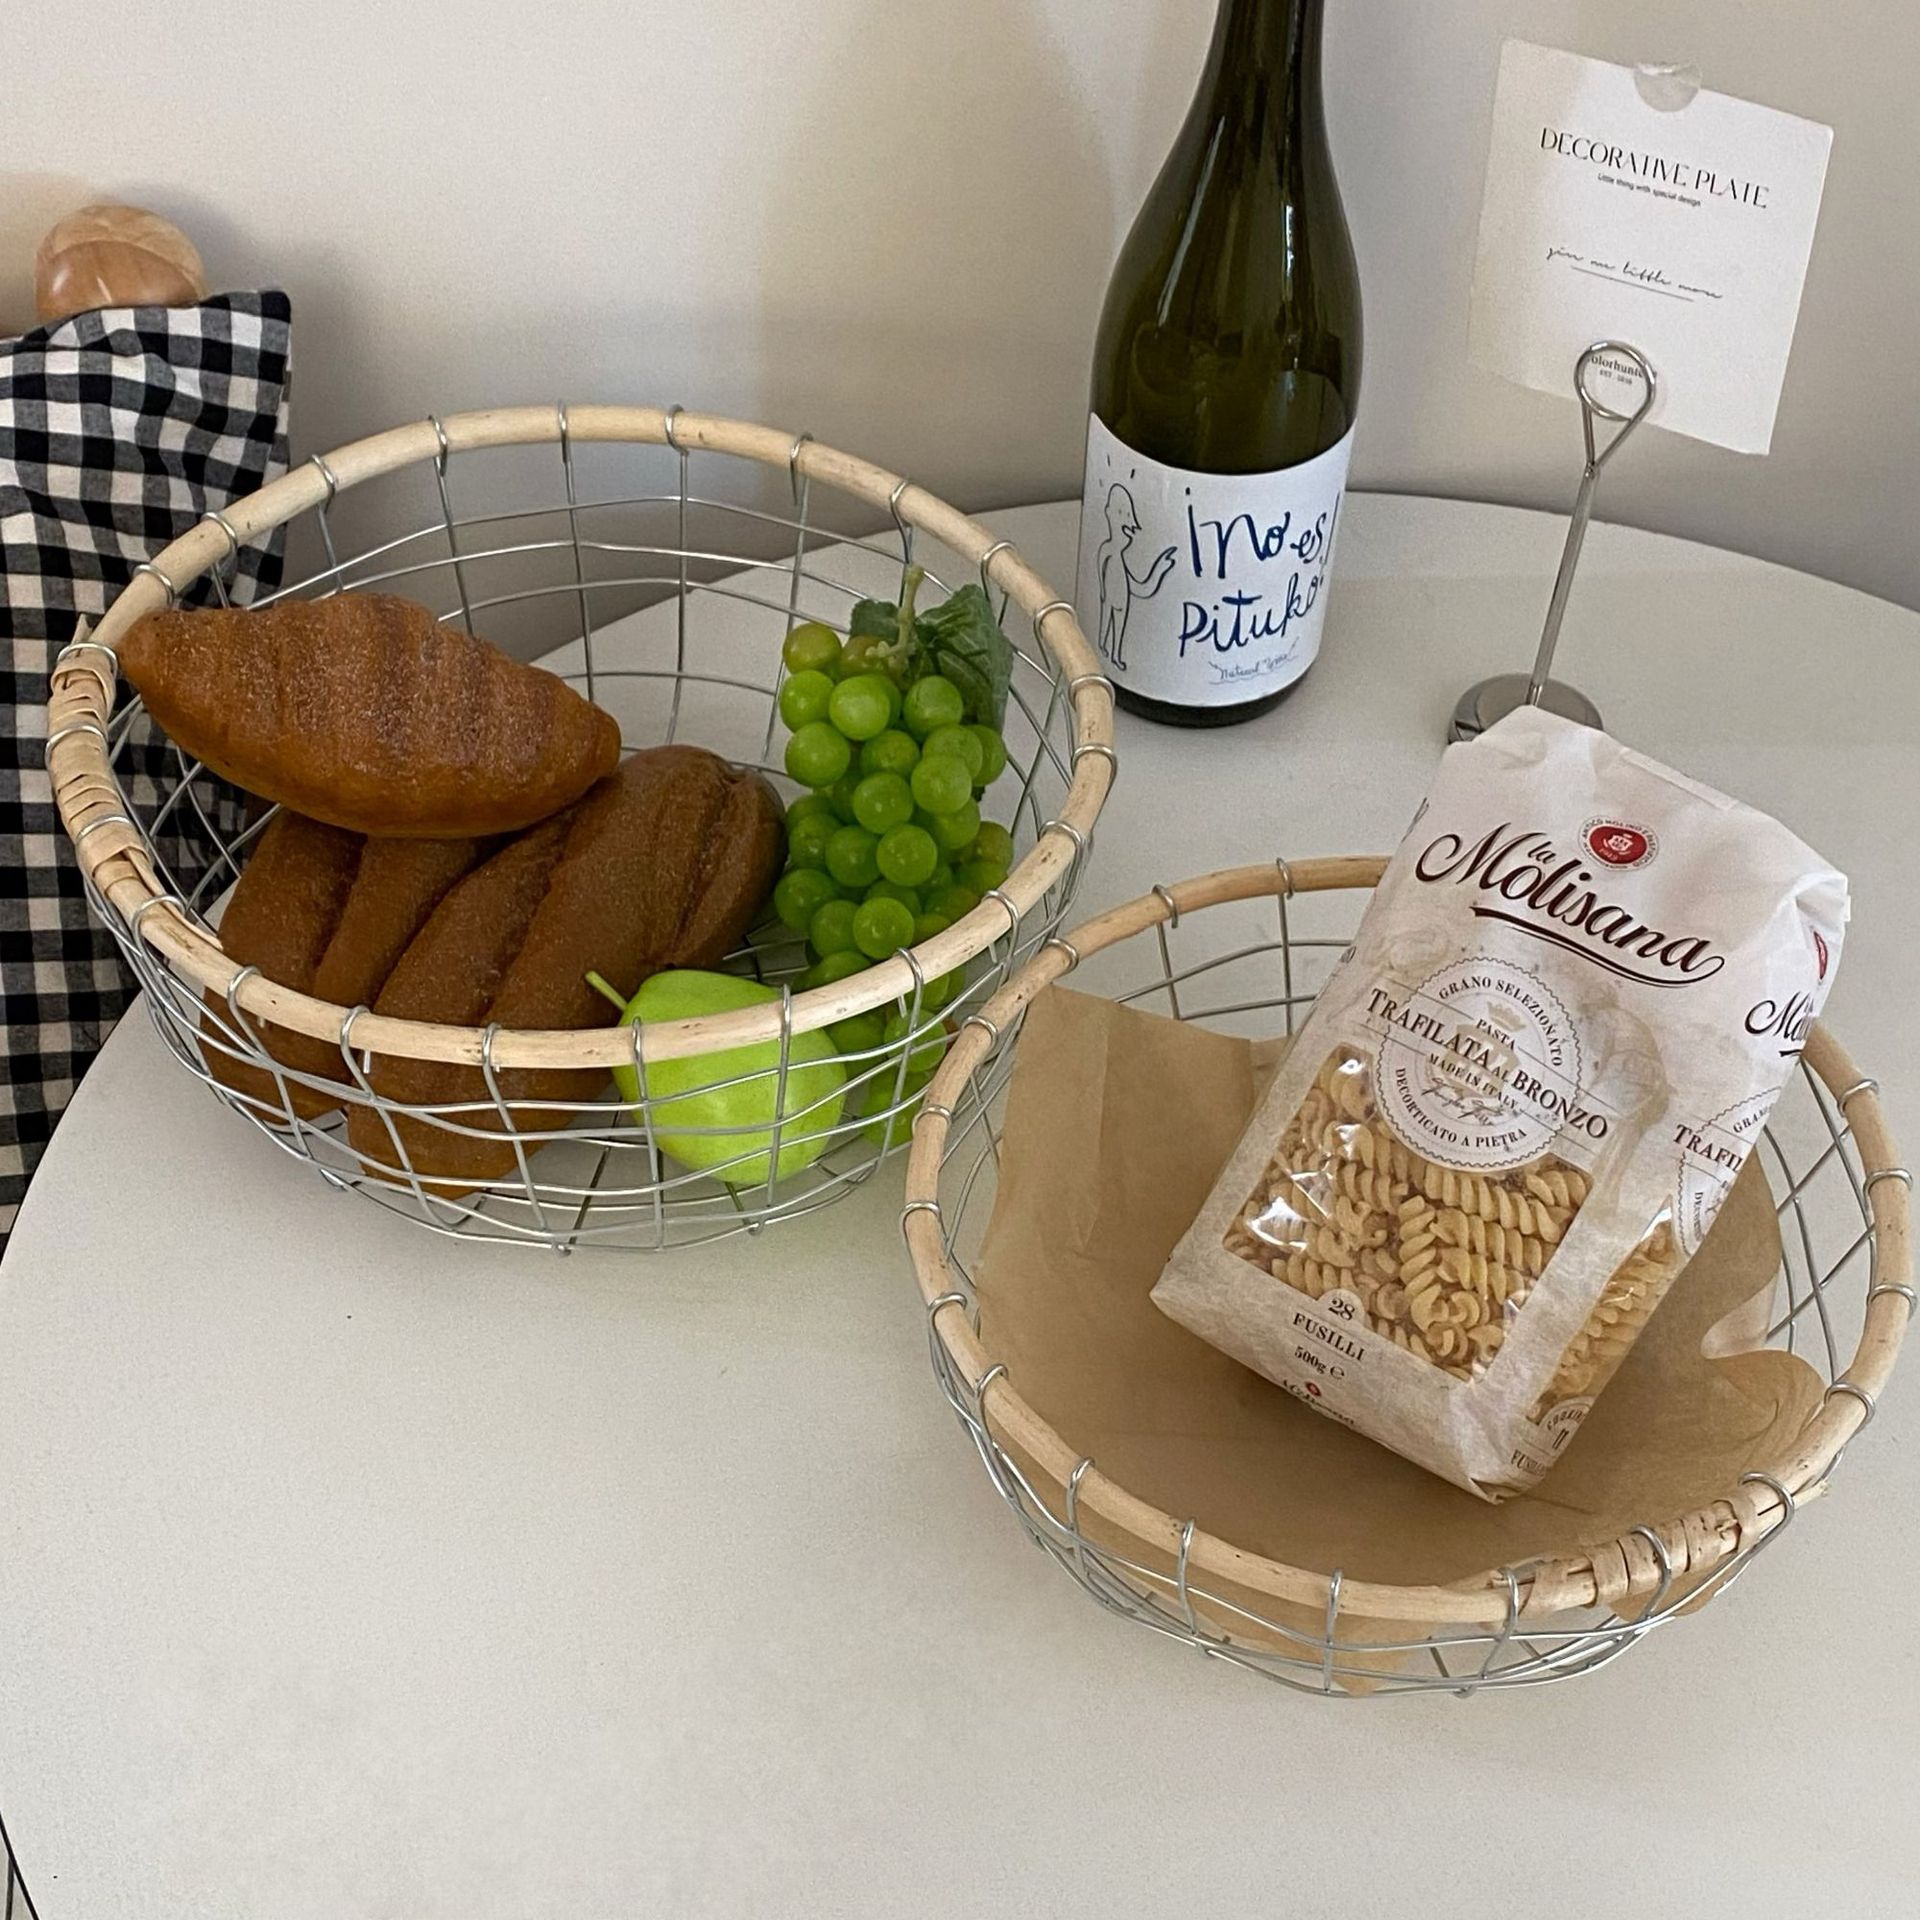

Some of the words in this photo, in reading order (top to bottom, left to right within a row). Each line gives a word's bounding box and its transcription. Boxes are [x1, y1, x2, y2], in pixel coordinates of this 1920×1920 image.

[1540, 127, 1689, 187] DECORATIVE
[1695, 169, 1770, 208] PLATE
[1527, 840, 1556, 864] la
[1415, 822, 1725, 974] Molisana
[1439, 975, 1492, 1001] GRANO
[1495, 979, 1564, 1067] SELEZIONATO
[1476, 1018, 1516, 1051] PASTA
[1367, 987, 1491, 1068] TRAFILATA
[1492, 1066, 1510, 1083] AL
[1511, 1069, 1609, 1140] BRONZO
[1430, 1053, 1465, 1077] MADE
[1465, 1072, 1481, 1087] IN
[1482, 1082, 1518, 1109] ITALY
[1395, 1068, 1458, 1144] DECORTICATO
[1461, 1133, 1470, 1147] A
[1475, 1128, 1527, 1148] PIETRA
[1293, 1313, 1366, 1361] FUSILLI
[1328, 1298, 1356, 1321] 28
[1294, 1346, 1327, 1375] 500g
